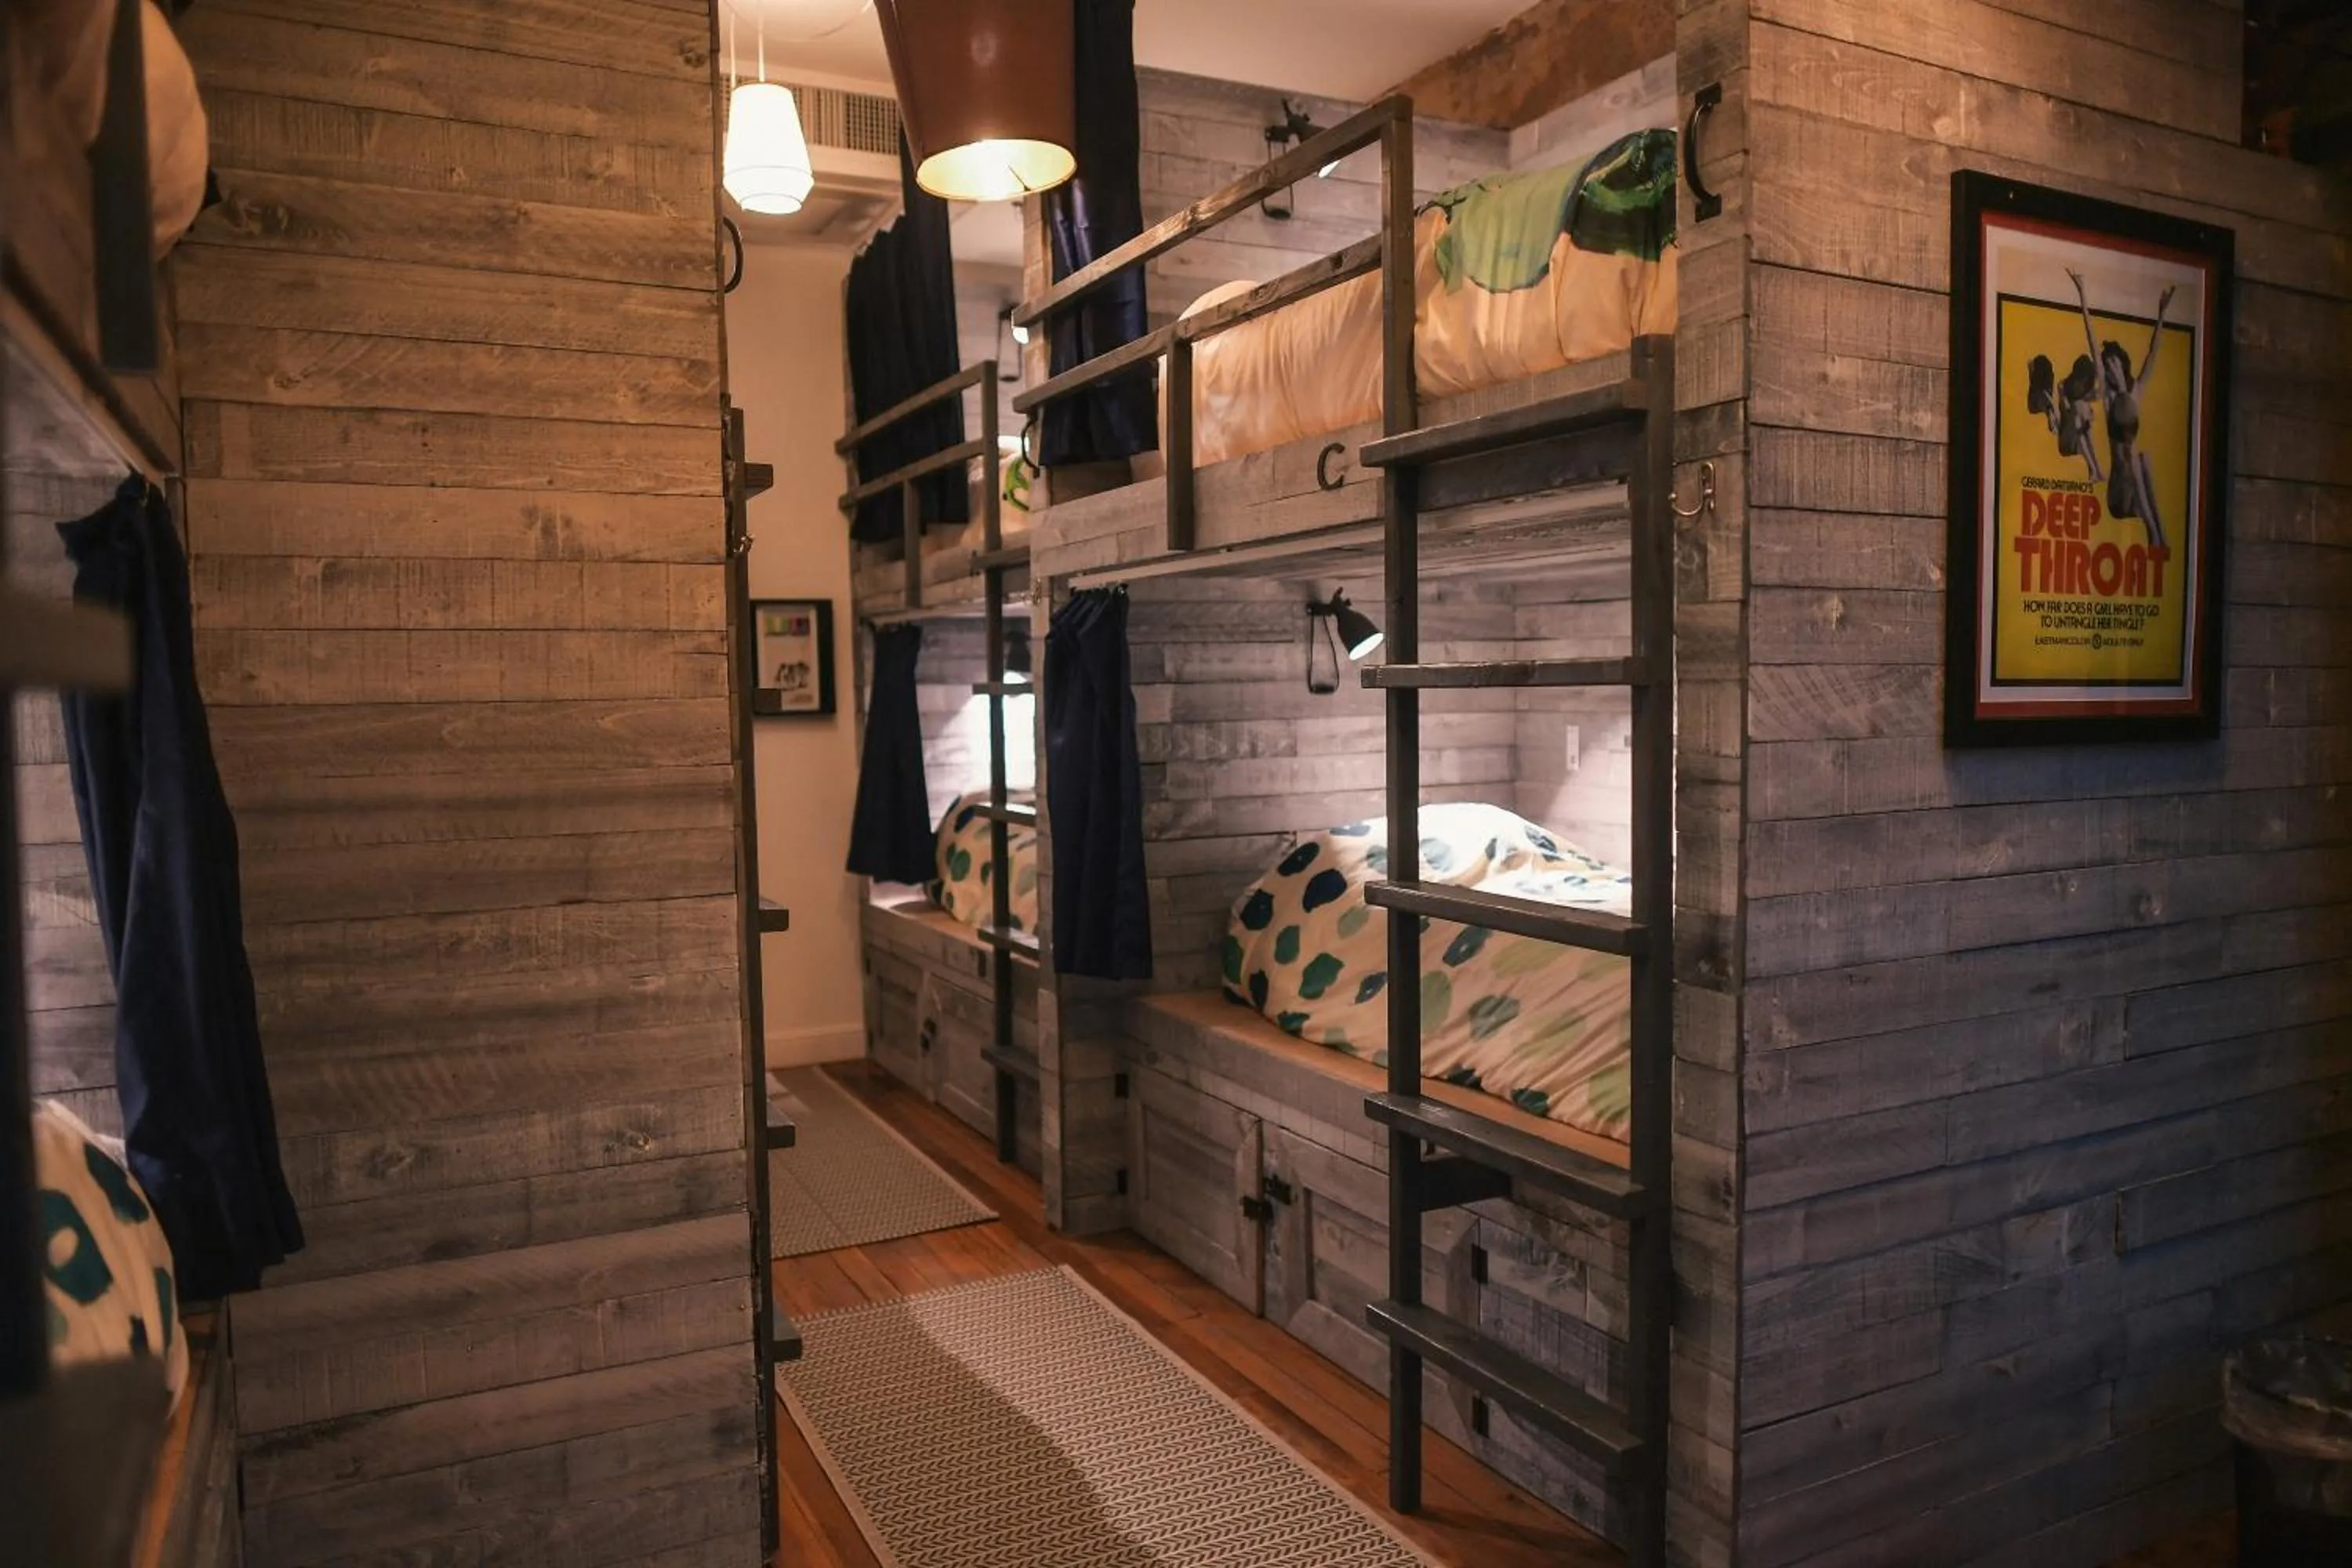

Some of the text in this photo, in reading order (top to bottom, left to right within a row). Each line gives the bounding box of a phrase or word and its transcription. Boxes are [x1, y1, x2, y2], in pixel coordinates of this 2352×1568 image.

[2022, 489, 2101, 540] DEEP
[2015, 538, 2171, 597] THROAT
[2024, 600, 2045, 613] HOW
[2047, 601, 2063, 613] FAR
[2063, 601, 2085, 615] DOES
[2086, 602, 2092, 615] A
[2094, 602, 2112, 615] GIRL
[2133, 604, 2145, 616] TO
[2146, 604, 2160, 617] GO
[2042, 615, 2053, 627] TO
